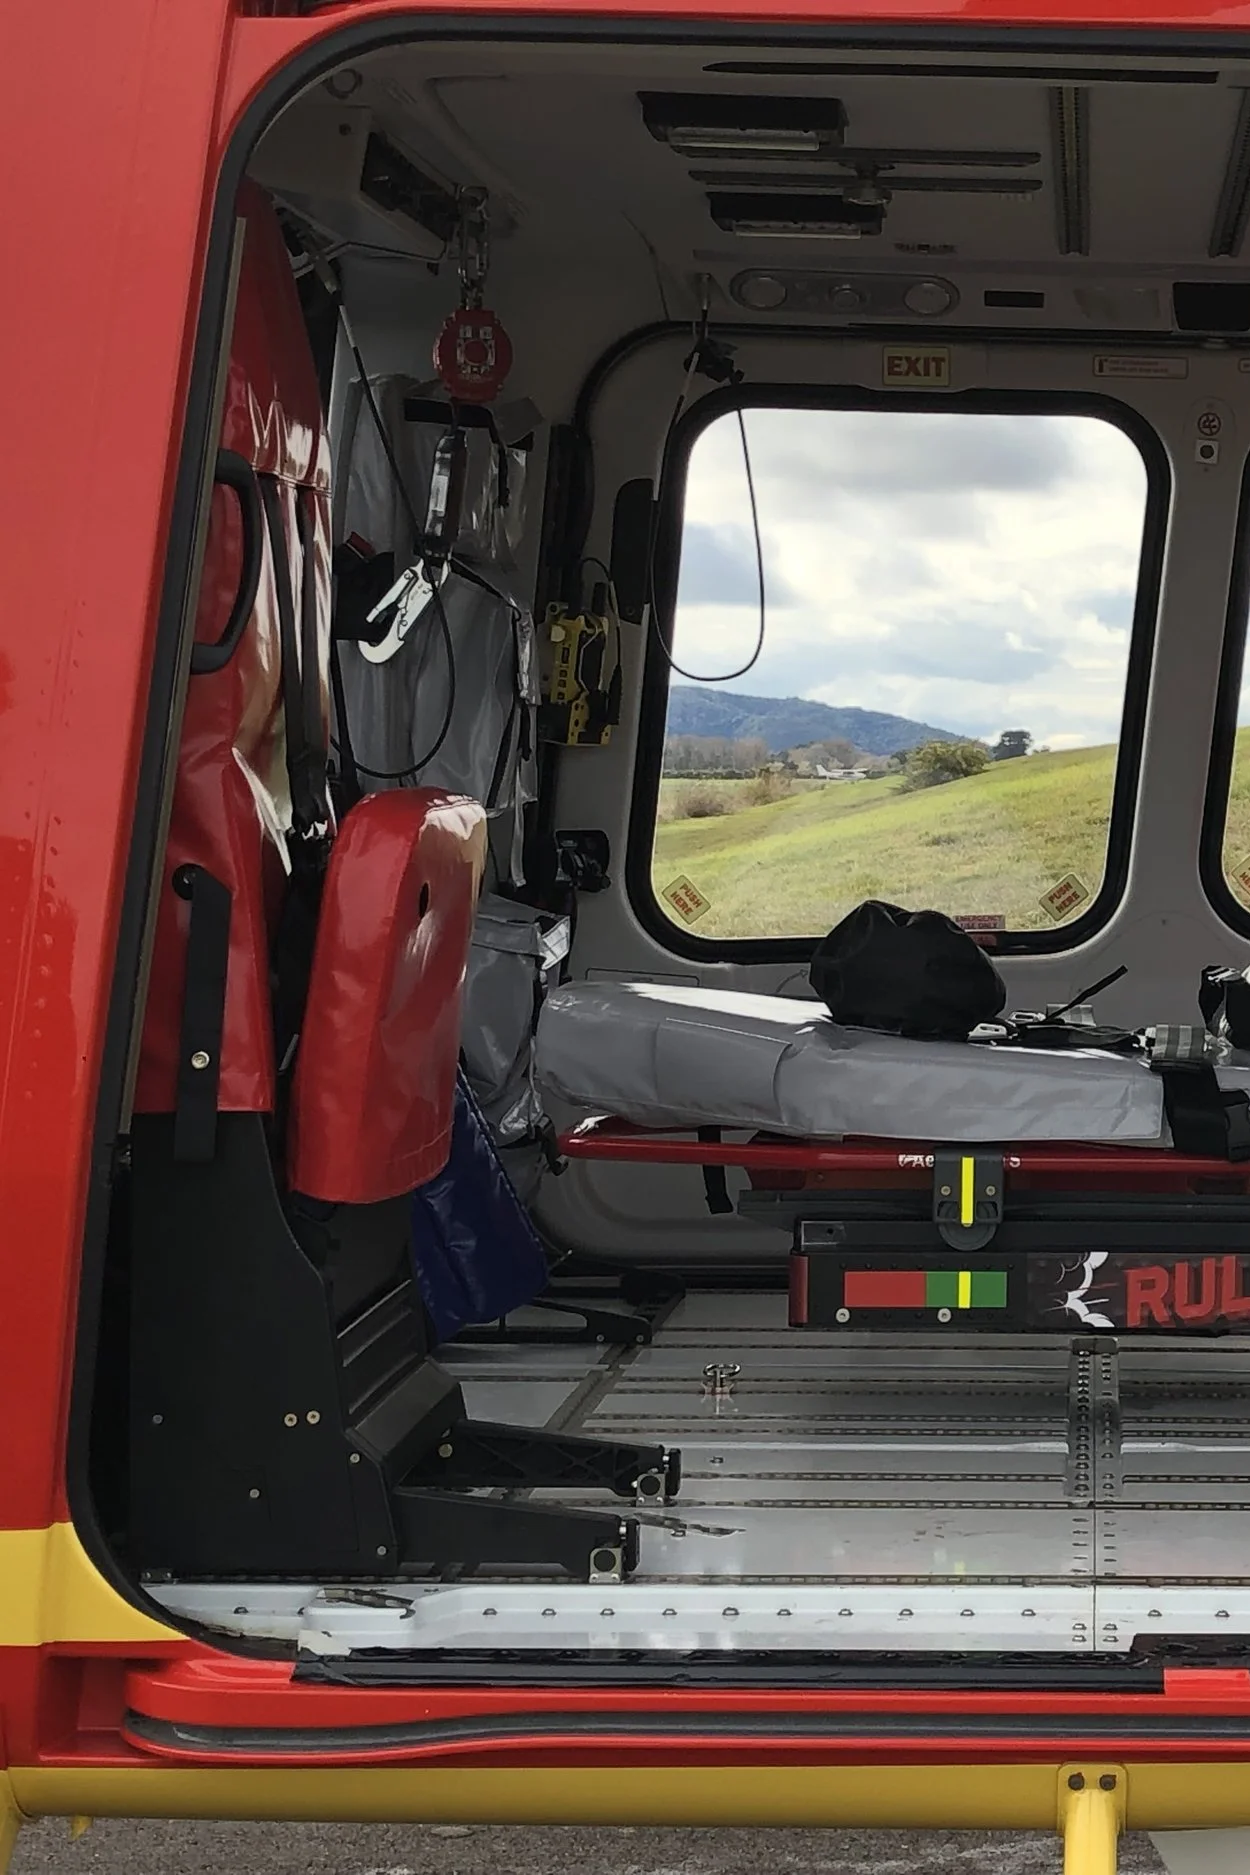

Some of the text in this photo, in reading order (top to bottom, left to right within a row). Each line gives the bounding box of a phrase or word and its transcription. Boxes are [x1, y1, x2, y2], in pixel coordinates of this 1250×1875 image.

[887, 355, 946, 377] EXIT
[670, 891, 694, 916] HERE
[679, 883, 703, 908] PUSH
[1048, 881, 1073, 904] PUSH
[1055, 890, 1080, 913] HERE
